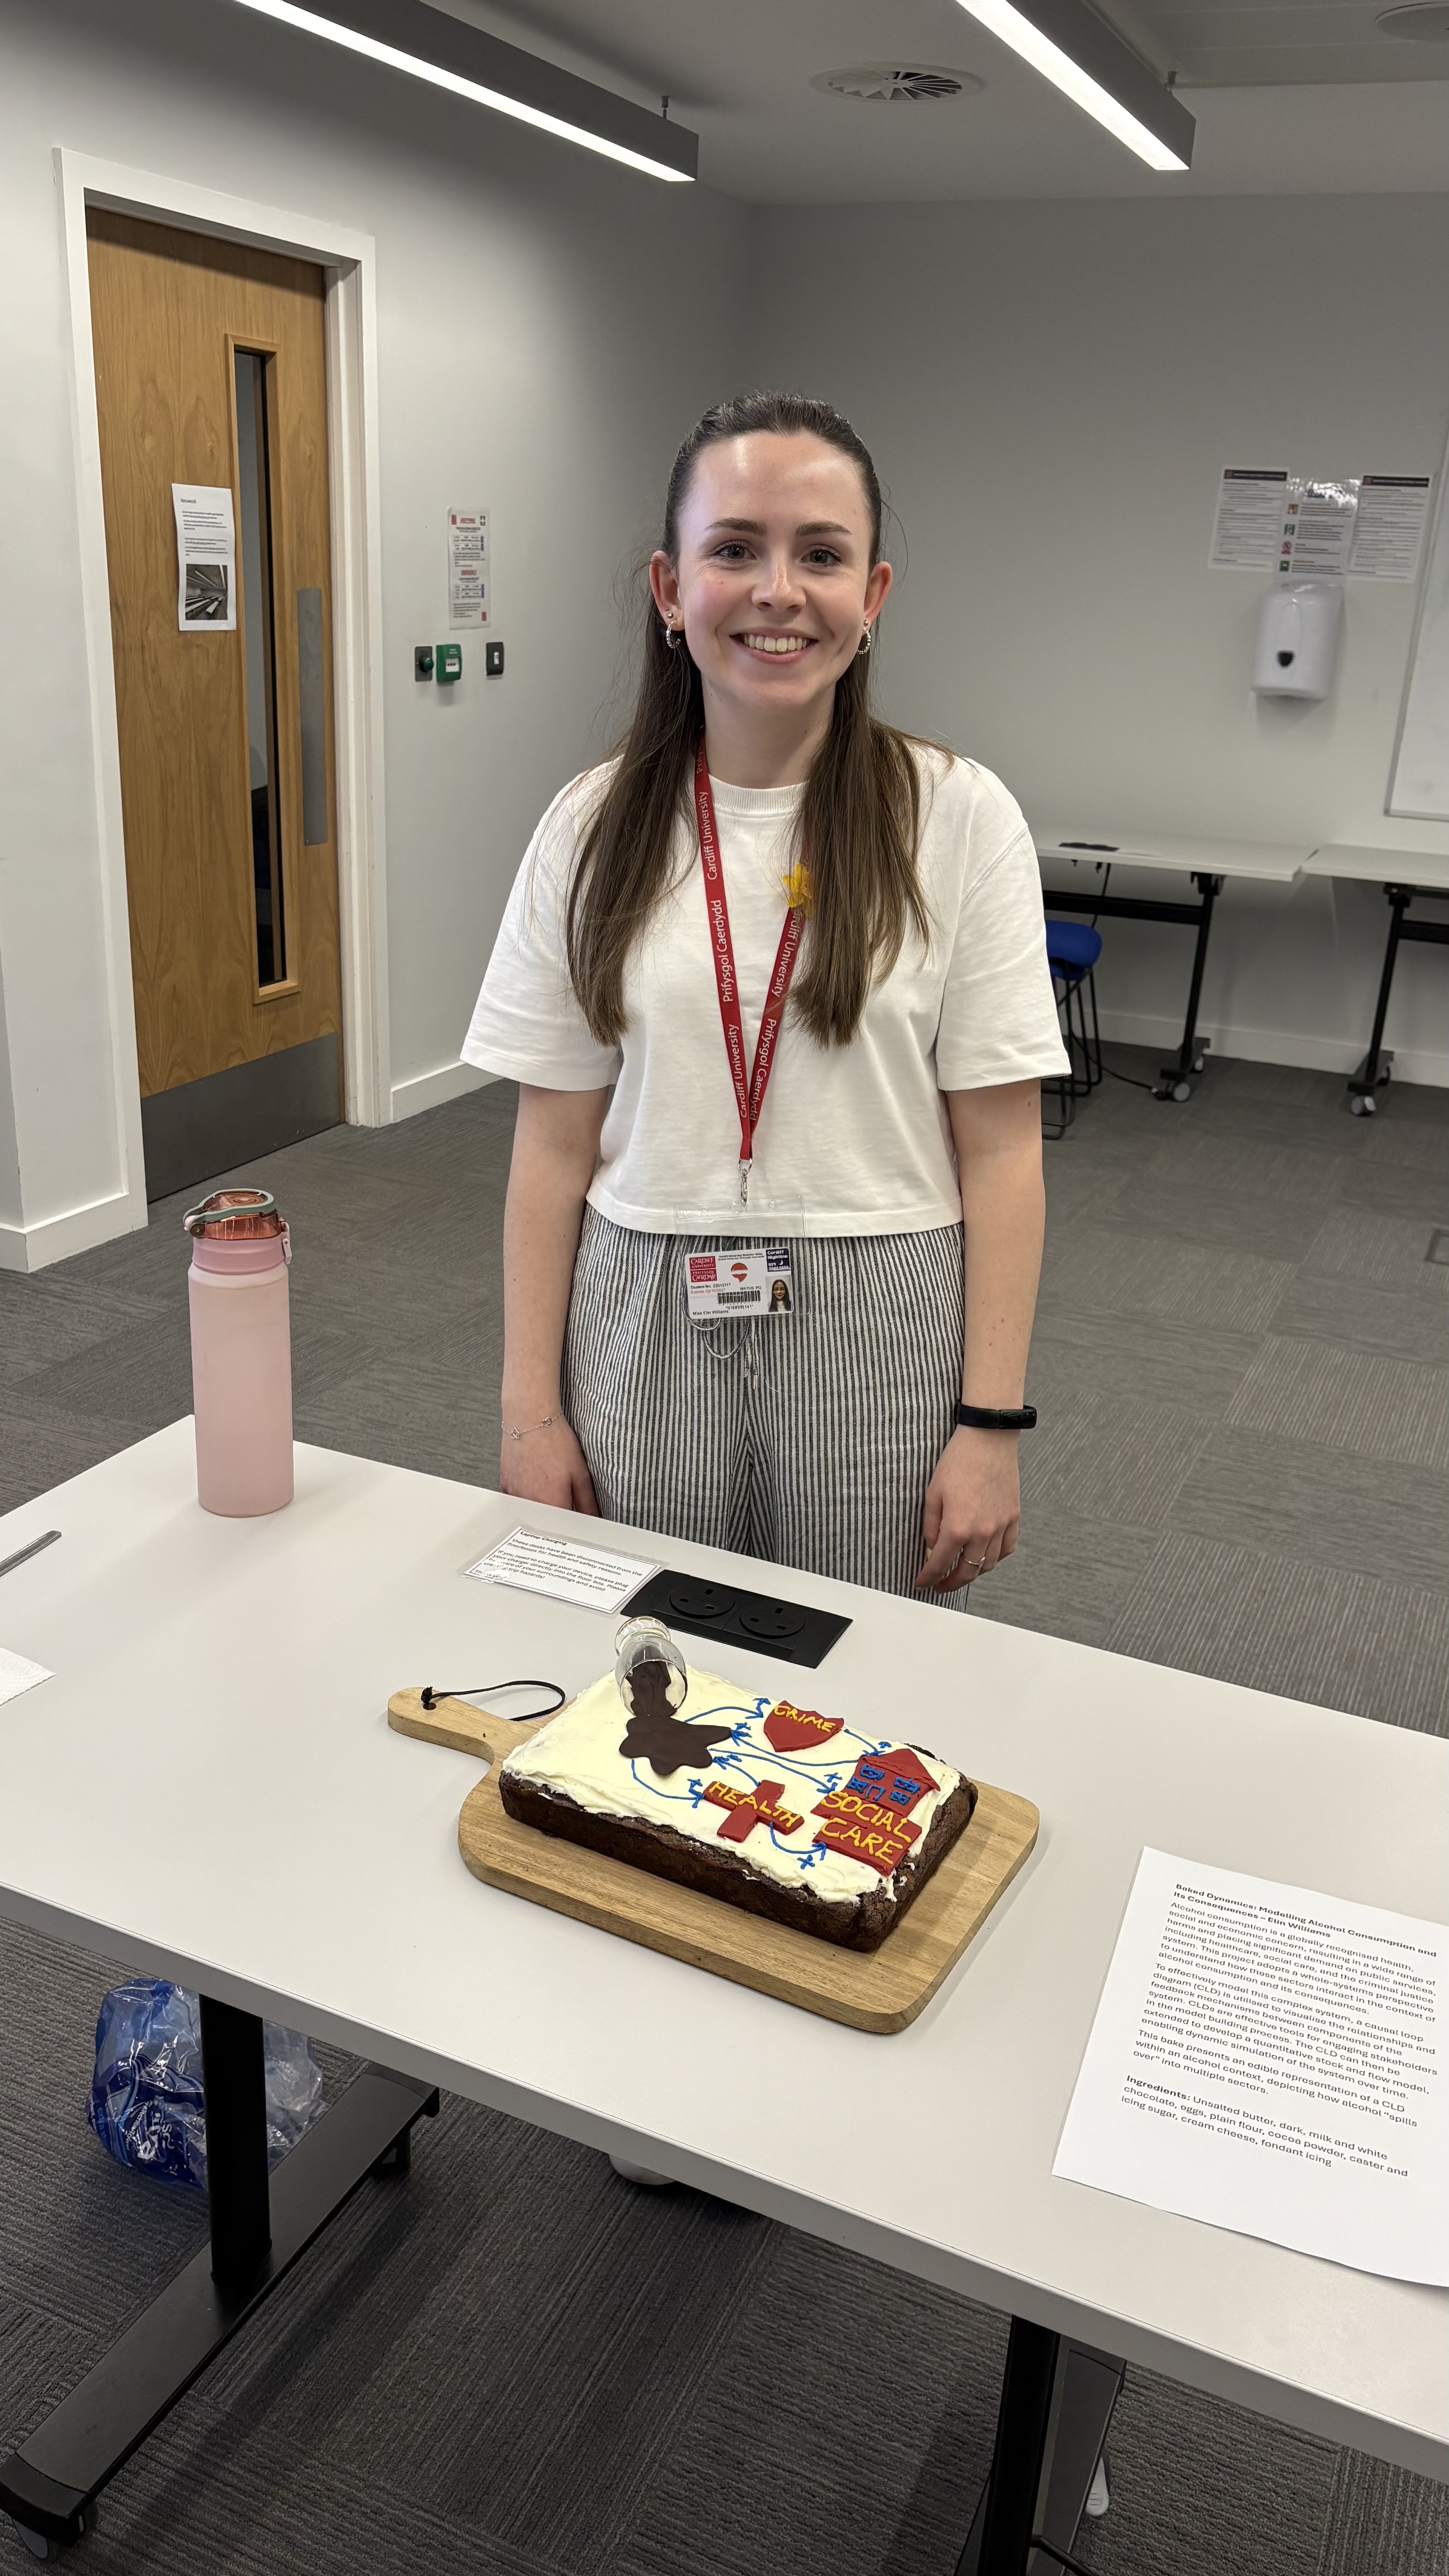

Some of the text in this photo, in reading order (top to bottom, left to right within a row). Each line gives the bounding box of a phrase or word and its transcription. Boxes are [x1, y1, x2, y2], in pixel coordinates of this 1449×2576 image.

[699, 792, 717, 880] Cardiff University
[711, 900, 733, 1002] Prifysgol Caerdydd
[772, 906, 802, 998] ardiff University
[728, 1024, 746, 1118] Cardiff University
[750, 1018, 777, 1121] Prifysgol Caerdydd
[691, 1257, 714, 1265] CARDIFF
[774, 1705, 836, 1733] CRIME
[708, 1781, 801, 1828] HEALTH
[821, 1791, 912, 1843] SOCIAL
[821, 1818, 903, 1865] CARE
[1170, 1902, 1205, 1916] Alcohol
[1207, 1914, 1268, 1933] consumption
[1287, 1934, 1325, 1948] globally
[1326, 1944, 1378, 1962] recognised
[1176, 1884, 1205, 1896] Baked
[1259, 1906, 1306, 1924] Modelling
[1308, 1919, 1345, 1933] Alcohol
[1348, 1929, 1416, 1951] Consumption
[1417, 1949, 1436, 1957] and
[1187, 1895, 1258, 1919] Consequences
[1268, 1917, 1286, 1926] Elin
[1288, 1922, 1331, 1938] Williams
[1146, 1998, 1155, 2006] in
[1157, 2002, 1173, 2010] the
[1175, 2007, 1206, 2019] model
[1208, 2015, 1248, 2032] building
[1295, 2039, 1313, 2050] The
[1316, 2046, 1338, 2057] CLD
[1340, 2055, 1359, 2064] can
[1361, 2060, 1385, 2072] then
[1387, 2067, 1400, 2076] be
[1155, 1963, 1166, 1971] To
[1168, 1968, 1217, 1986] effectively
[1218, 1982, 1249, 1994] model
[1251, 1990, 1269, 2000] this
[1271, 1996, 1313, 2012] complex
[1365, 2022, 1398, 2036] causal
[1401, 2031, 1423, 2042] loop
[1188, 2000, 1214, 2012] CLDs
[1235, 2014, 1277, 2030] effective
[1279, 2026, 1304, 2038] tools
[1307, 2033, 1321, 2042] for
[1322, 2040, 1368, 2058] engaging
[1370, 2053, 1437, 2075] stakeholders
[1136, 2040, 1165, 2054] within
[1168, 2050, 1180, 2058] an
[1182, 2055, 1220, 2070] alcohol
[1266, 2078, 1315, 2098] depicting
[1317, 2091, 1340, 2103] how
[1342, 2100, 1382, 2116] alcohol
[1139, 2029, 1158, 2040] This
[1160, 2036, 1184, 2048] bake
[1186, 2045, 1230, 2061] presents
[1232, 2058, 1245, 2066] an
[1247, 2062, 1279, 2075] edible
[1281, 2072, 1357, 2098] representation
[1382, 2101, 1405, 2112] CLD
[1141, 2018, 1184, 2035] enabling
[1186, 2030, 1228, 2046] dynamic
[1230, 2042, 1284, 2062] simulation
[1299, 2061, 1316, 2071] the
[1318, 2068, 1355, 2083] system
[1357, 2080, 1380, 2090] over
[1144, 2009, 1189, 2025] extended
[1203, 2024, 1242, 2040] develop
[1253, 2039, 1313, 2060] quantitative
[1316, 2057, 1343, 2070] stock
[1346, 2066, 1366, 2076] and
[1368, 2072, 1390, 2083] flow
[1162, 2058, 1181, 2068] into
[1183, 2065, 1225, 2081] multiple
[1121, 2095, 1146, 2110] icing
[1181, 2116, 1214, 2131] cream
[1261, 2139, 1303, 2157] fondant
[1306, 2152, 1332, 2167] icing
[1193, 2096, 1240, 2116] Unsalted
[1309, 2131, 1332, 2144] milk
[1334, 2139, 1355, 2150] and
[1357, 2146, 1387, 2160] white
[1210, 2113, 1236, 2126] plain
[1268, 2131, 1301, 2145] cocoa
[1349, 2156, 1385, 2171] caster
[1387, 2167, 1408, 2177] and
